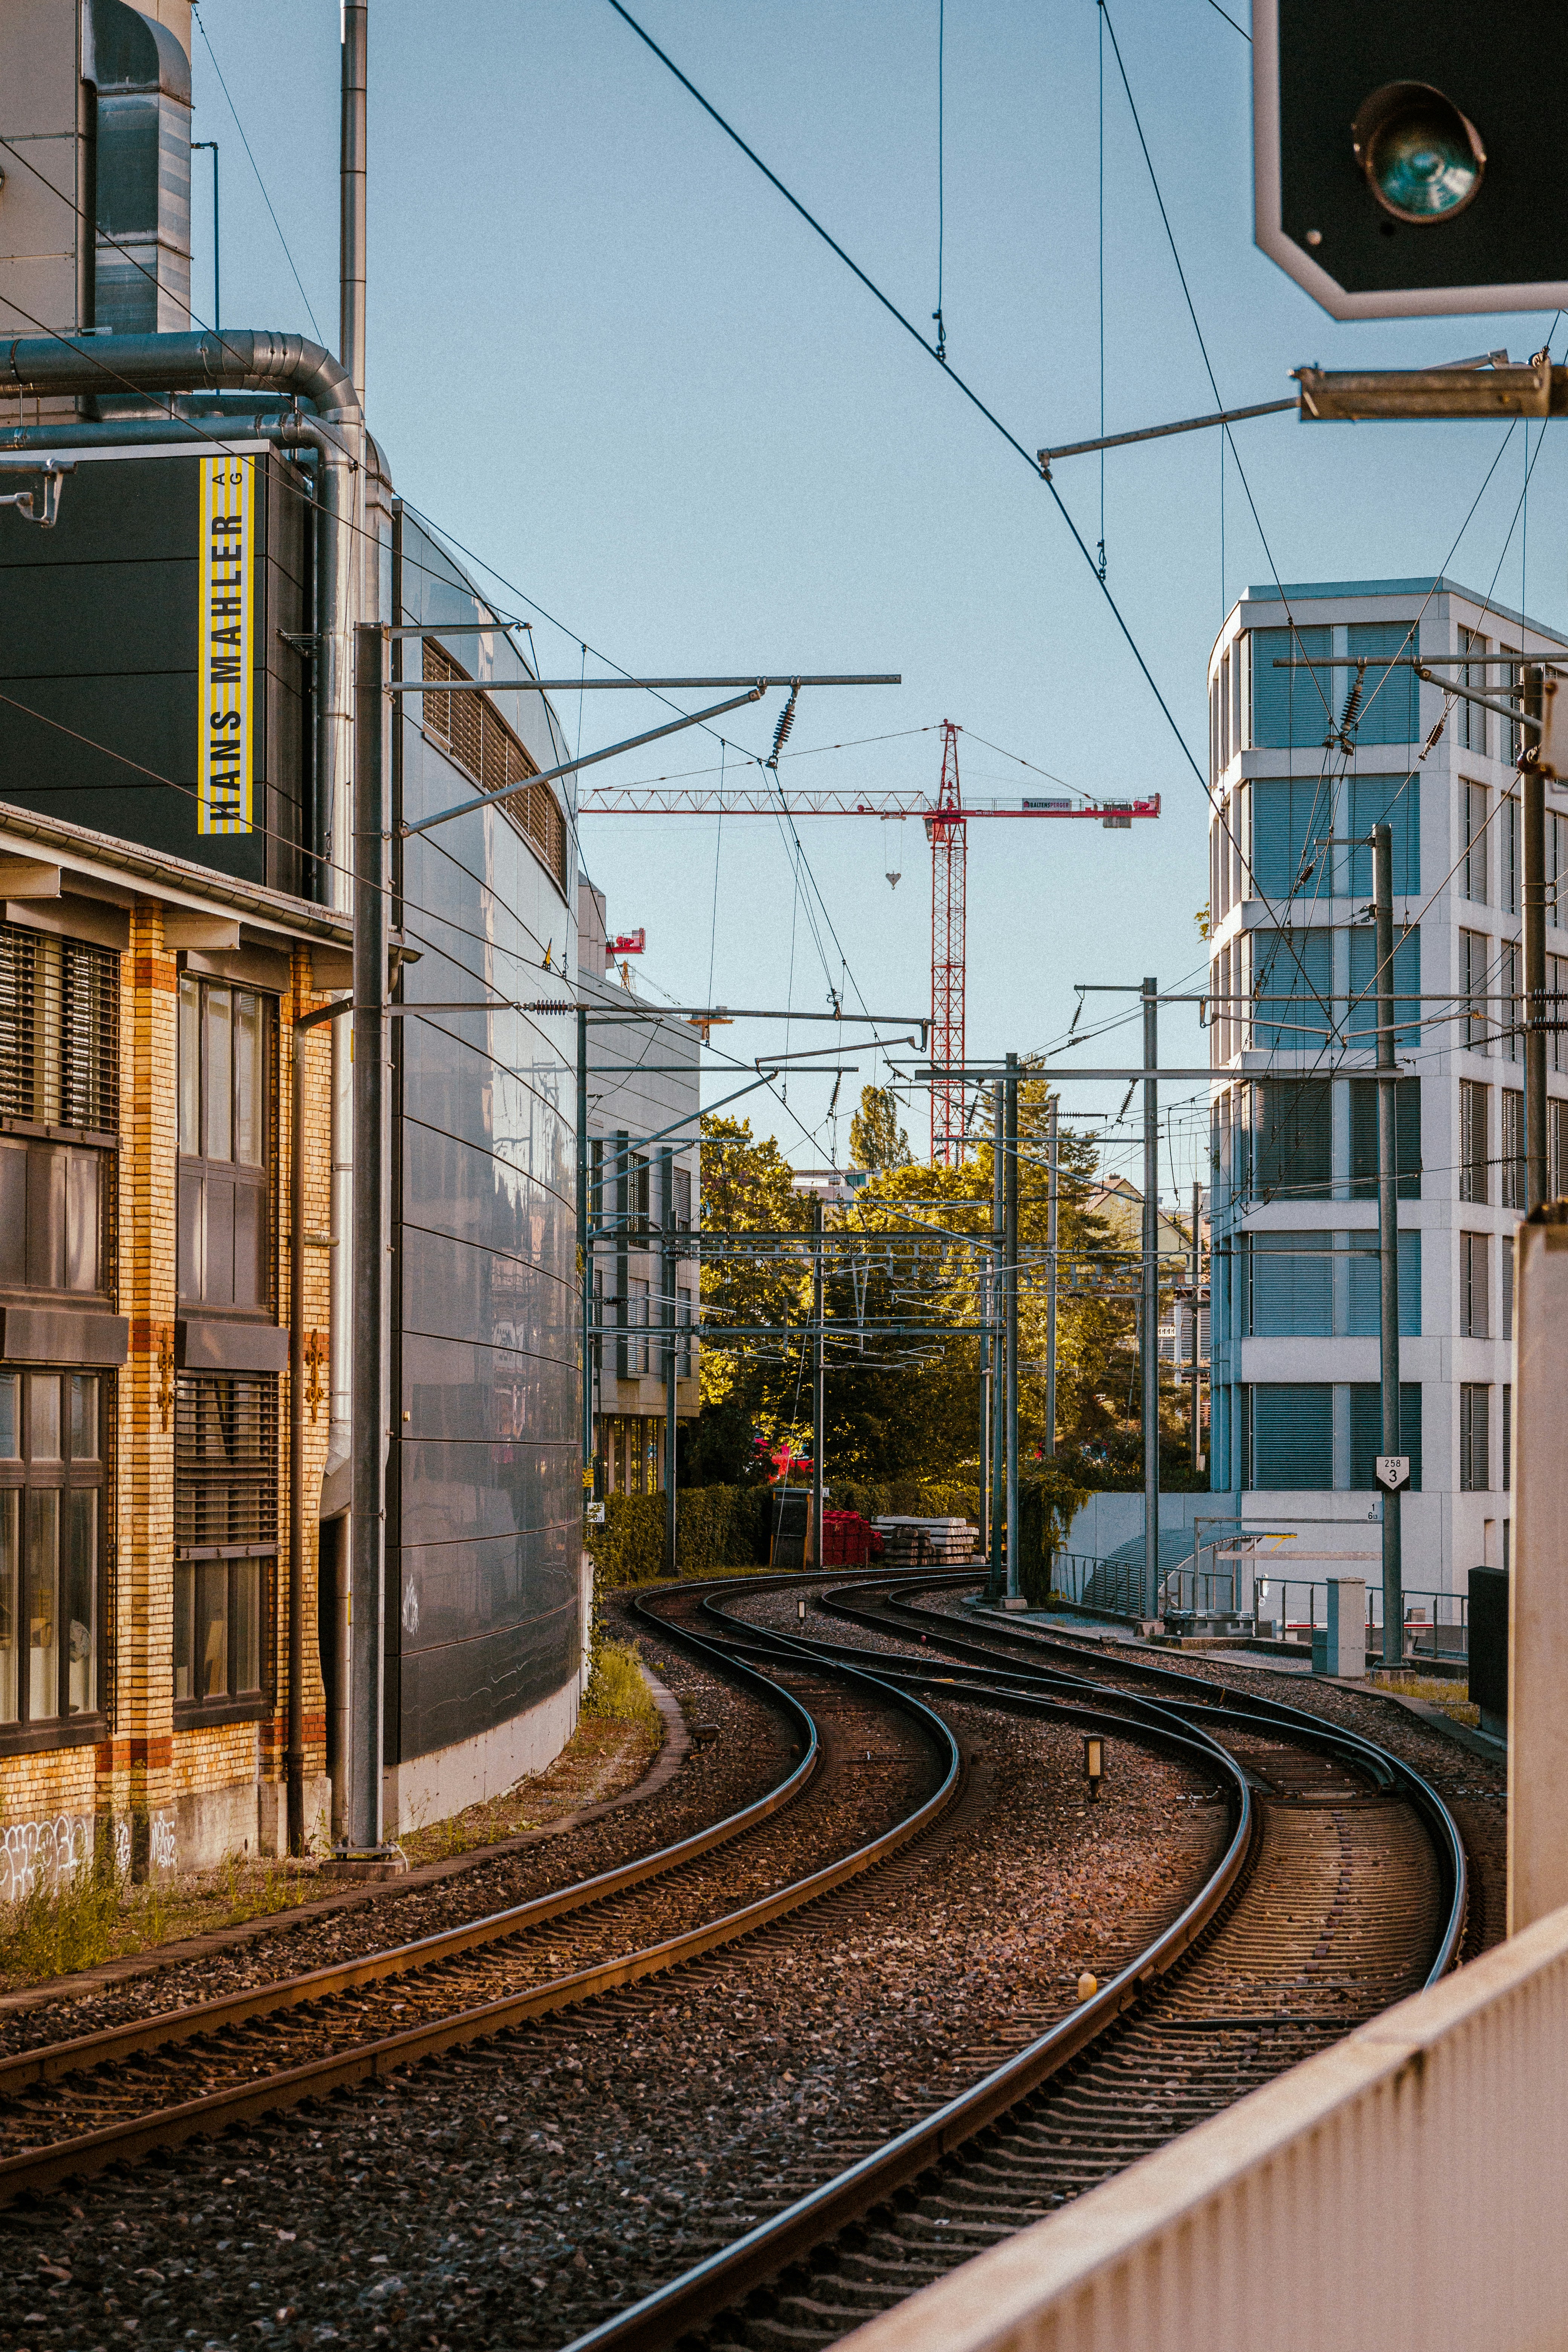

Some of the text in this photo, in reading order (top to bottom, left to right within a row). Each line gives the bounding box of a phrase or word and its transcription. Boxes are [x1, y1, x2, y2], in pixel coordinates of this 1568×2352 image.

[210, 515, 242, 821] HANS MAHLER
[1389, 1469, 1397, 1482] 3
